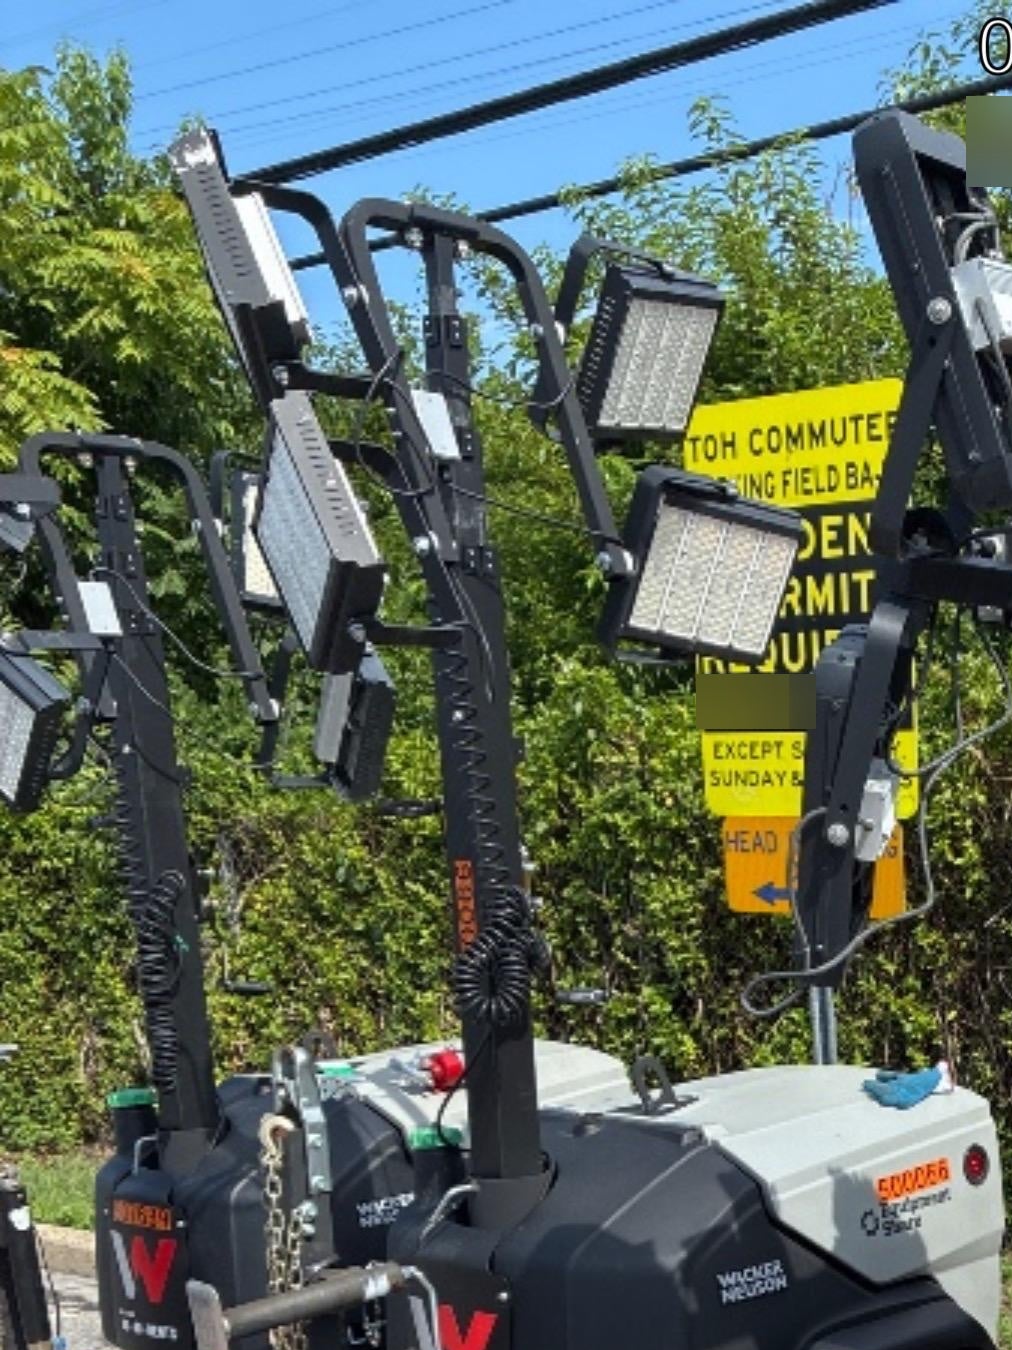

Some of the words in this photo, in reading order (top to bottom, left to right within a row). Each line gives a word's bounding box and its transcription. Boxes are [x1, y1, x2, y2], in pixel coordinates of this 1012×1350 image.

[688, 431, 737, 464] TOH
[781, 464, 840, 499] FIELD
[779, 570, 877, 618] RMIT
[713, 741, 784, 760] EXCEPT
[710, 769, 787, 788] SUNDAY
[724, 830, 778, 853] HEAD
[716, 1259, 784, 1287] WACKER
[721, 1274, 788, 1303] NEUSON
